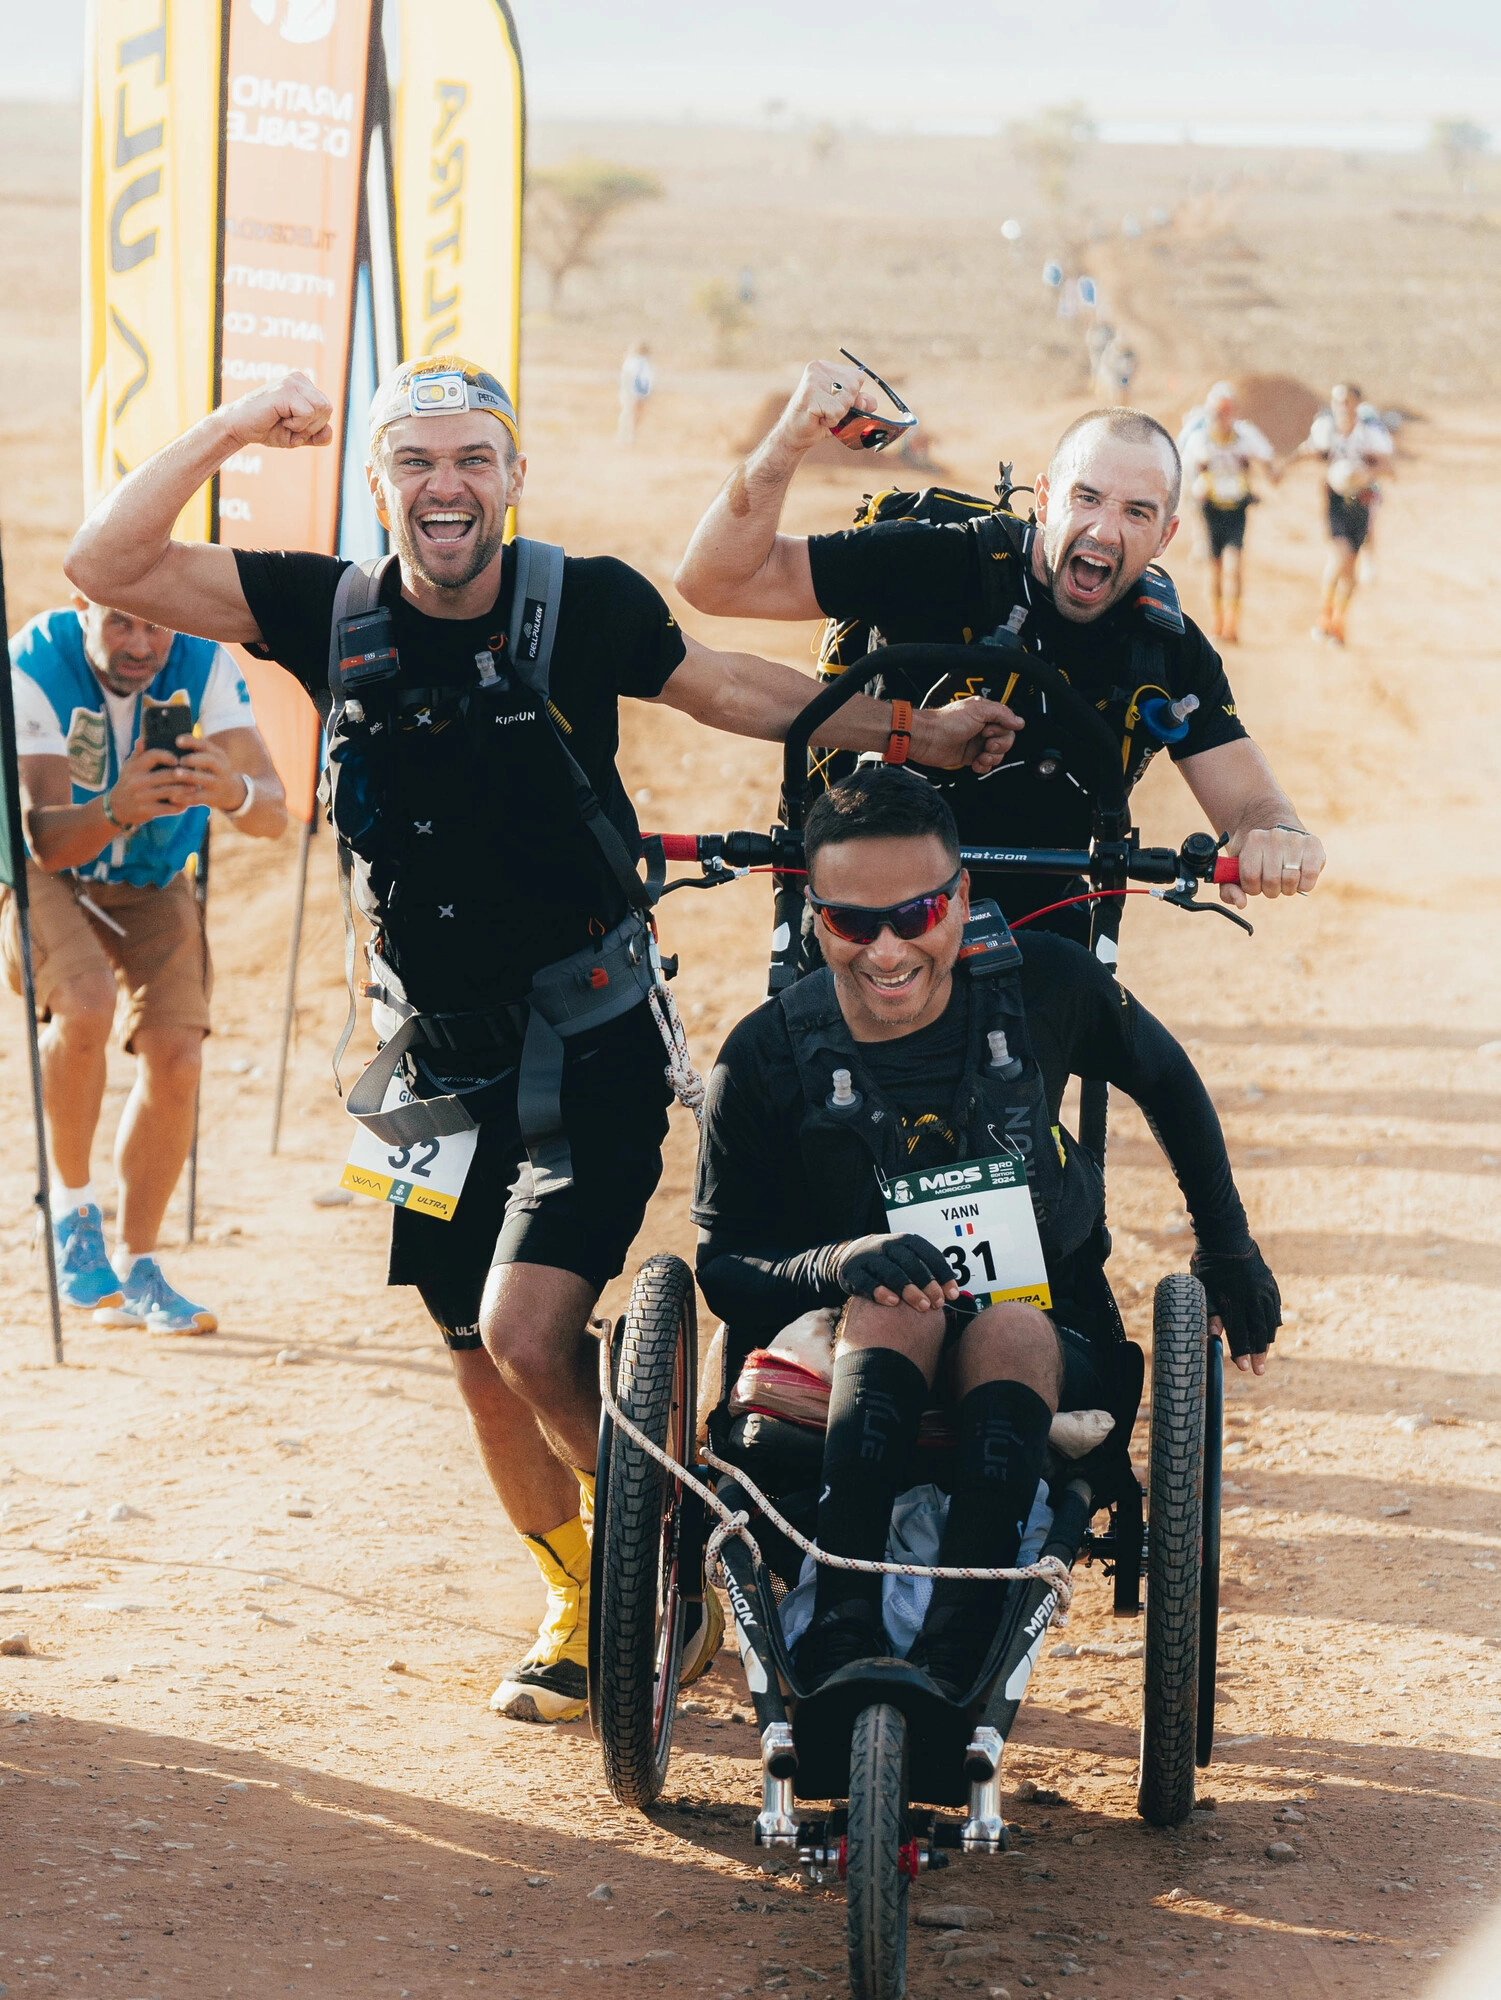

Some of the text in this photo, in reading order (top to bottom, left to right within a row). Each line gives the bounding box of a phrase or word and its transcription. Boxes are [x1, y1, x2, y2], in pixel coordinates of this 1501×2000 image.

[388, 1137, 440, 1178] 32
[988, 1160, 1013, 1173] 3RD
[990, 1170, 1015, 1178] EDITION
[918, 1166, 983, 1191] MDS
[991, 1176, 1016, 1185] 2024
[935, 1184, 971, 1195] MOROCCO
[417, 1195, 447, 1210] ULTRA
[941, 1203, 980, 1221] YANN
[943, 1240, 997, 1288] 31
